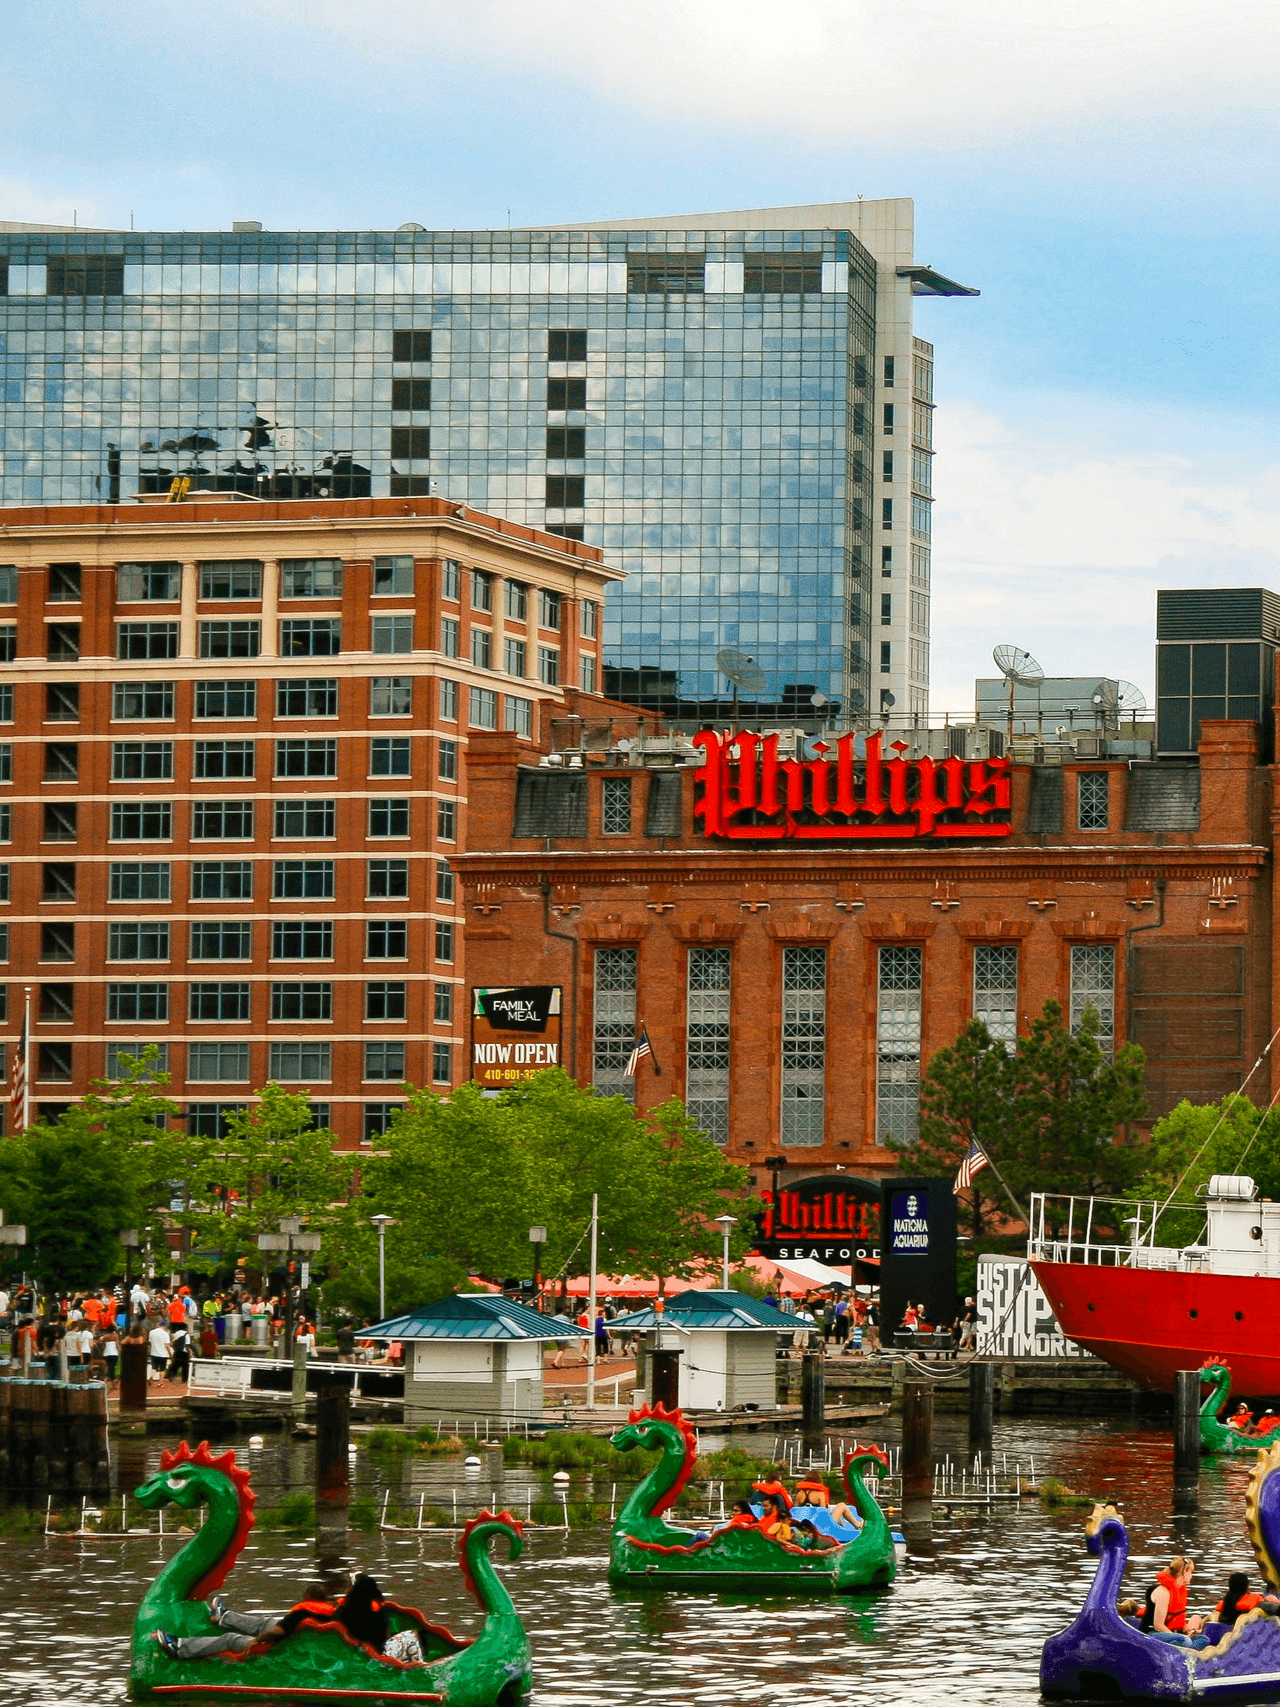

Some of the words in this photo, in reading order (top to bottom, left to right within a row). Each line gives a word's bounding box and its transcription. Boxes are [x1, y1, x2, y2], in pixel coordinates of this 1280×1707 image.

[693, 729, 1013, 839] Phillips
[493, 1000, 534, 1012] FAMILY
[507, 1010, 541, 1022] MEAL
[474, 1043, 513, 1064] NOW
[514, 1043, 558, 1064] OPEN
[484, 1068, 538, 1080] 410-601-32
[761, 1189, 881, 1239] Phillip
[893, 1219, 929, 1233] NATIONA
[976, 1289, 1064, 1336] SHIP
[976, 1333, 1080, 1357] BALTIMORE
